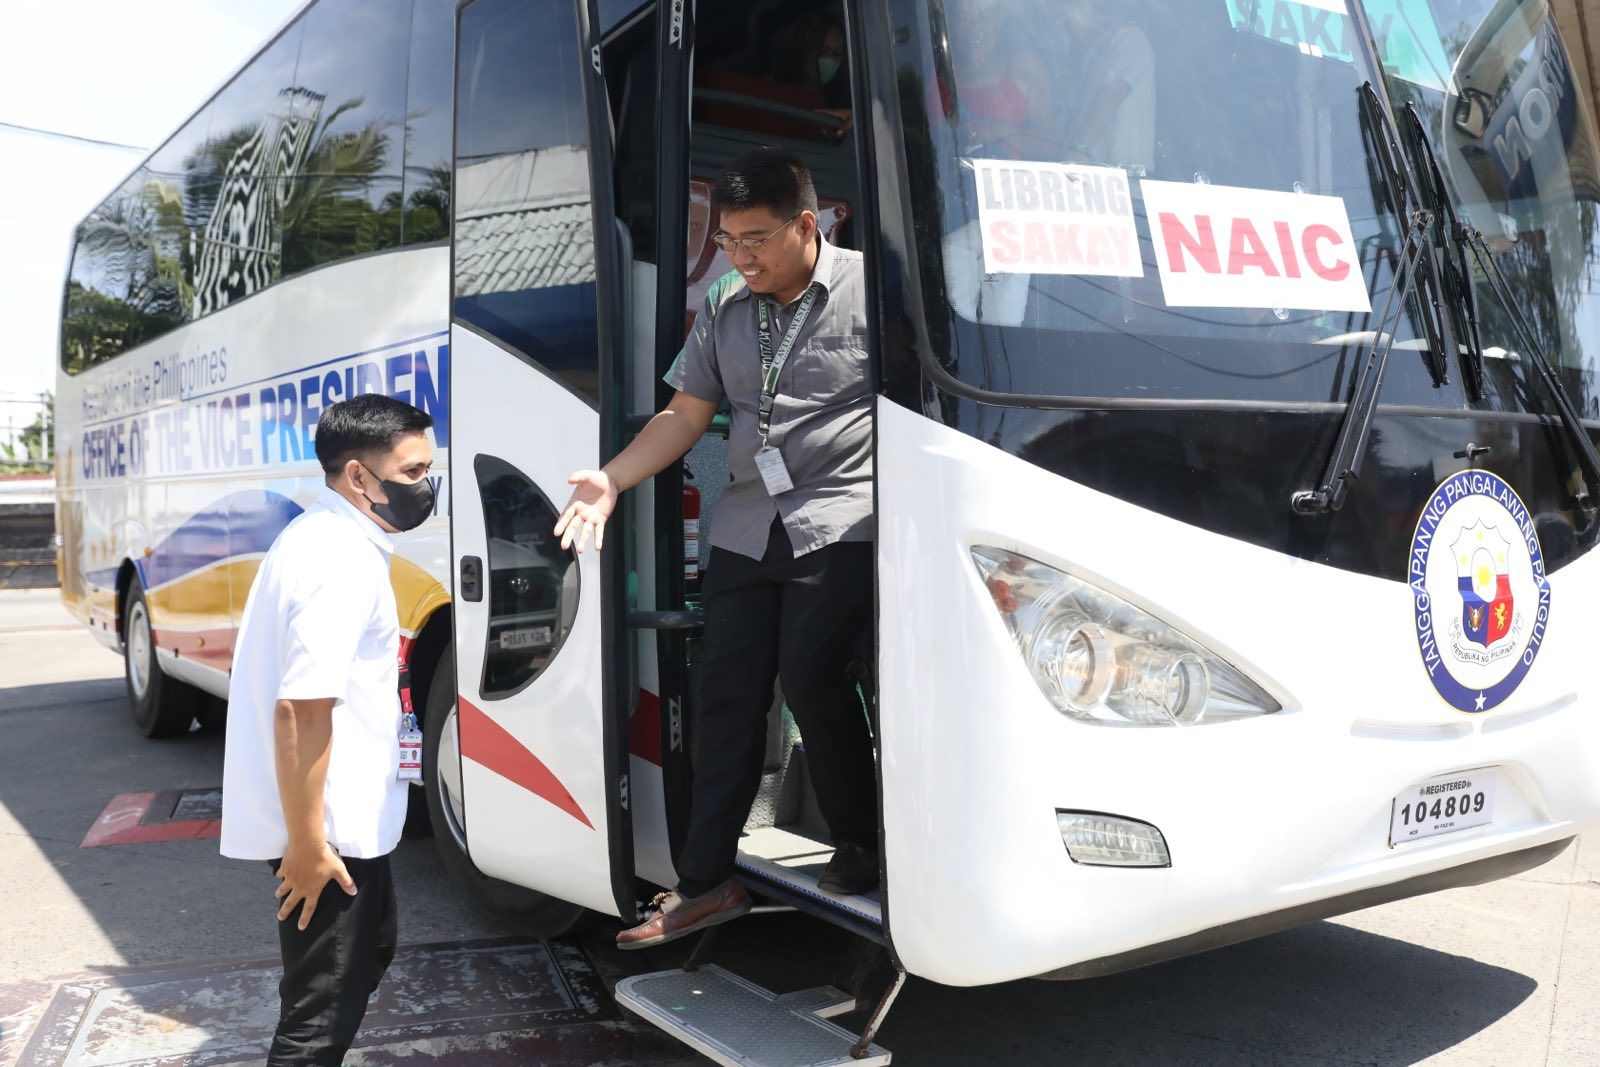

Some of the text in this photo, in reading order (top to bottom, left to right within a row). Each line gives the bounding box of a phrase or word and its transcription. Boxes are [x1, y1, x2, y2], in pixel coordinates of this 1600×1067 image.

[982, 167, 1129, 217] LIBRENG
[989, 221, 1134, 267] SAKAY
[1158, 212, 1351, 282] NAIC
[773, 328, 795, 365] CAVITE
[790, 302, 806, 331] WEST
[132, 366, 151, 408] the
[153, 346, 228, 402] Philippines
[82, 343, 449, 480] OFFICE OF THE VICE PREN
[1410, 475, 1550, 677] TANGGAPAN NG PANGALAWANG PANGULO
[1453, 642, 1480, 662] REPUBLIKA
[1401, 792, 1485, 826] 104809
[1425, 781, 1467, 795] REGISTERED
